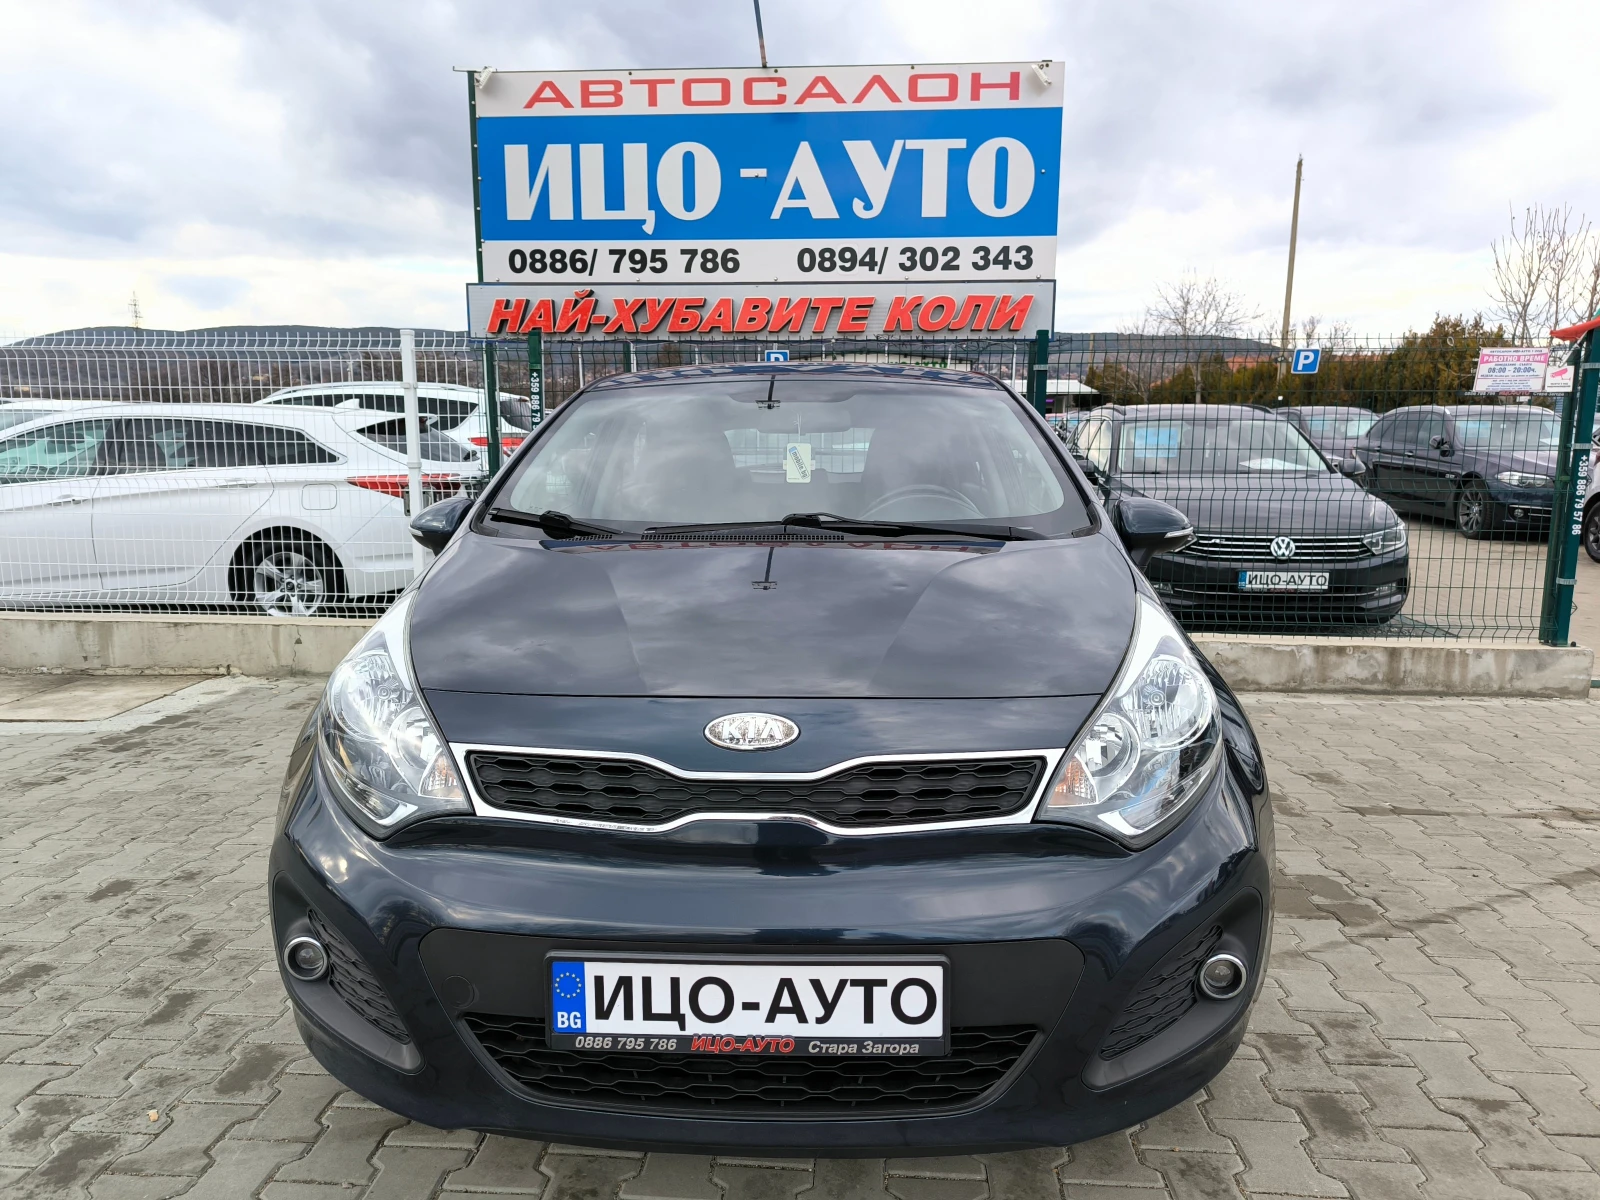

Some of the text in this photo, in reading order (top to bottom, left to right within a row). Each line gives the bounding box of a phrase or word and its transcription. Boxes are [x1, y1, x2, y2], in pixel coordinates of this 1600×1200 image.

[523, 71, 1020, 109] АВТОСАЛОН
[508, 248, 740, 276] 0886/ 795 786
[797, 245, 1034, 275] 0894/ 302 343
[487, 288, 1035, 333] НАЙ-ХУБАВИТЕ КОЛИ
[1297, 351, 1315, 371] P
[530, 372, 540, 392] +359
[530, 394, 540, 410] 886
[532, 412, 541, 422] 79
[1572, 455, 1588, 535] +359 886 79 57 86
[1248, 573, 1327, 588] ИЦО-АУТО
[722, 719, 784, 740] KIA
[593, 974, 937, 1031] ИЦО-АУТО
[556, 1011, 582, 1029] BG
[575, 1036, 677, 1050] 0886 795 786
[691, 1034, 796, 1054] ИЦО-АУТО
[808, 1041, 920, 1055] Стара Загора
